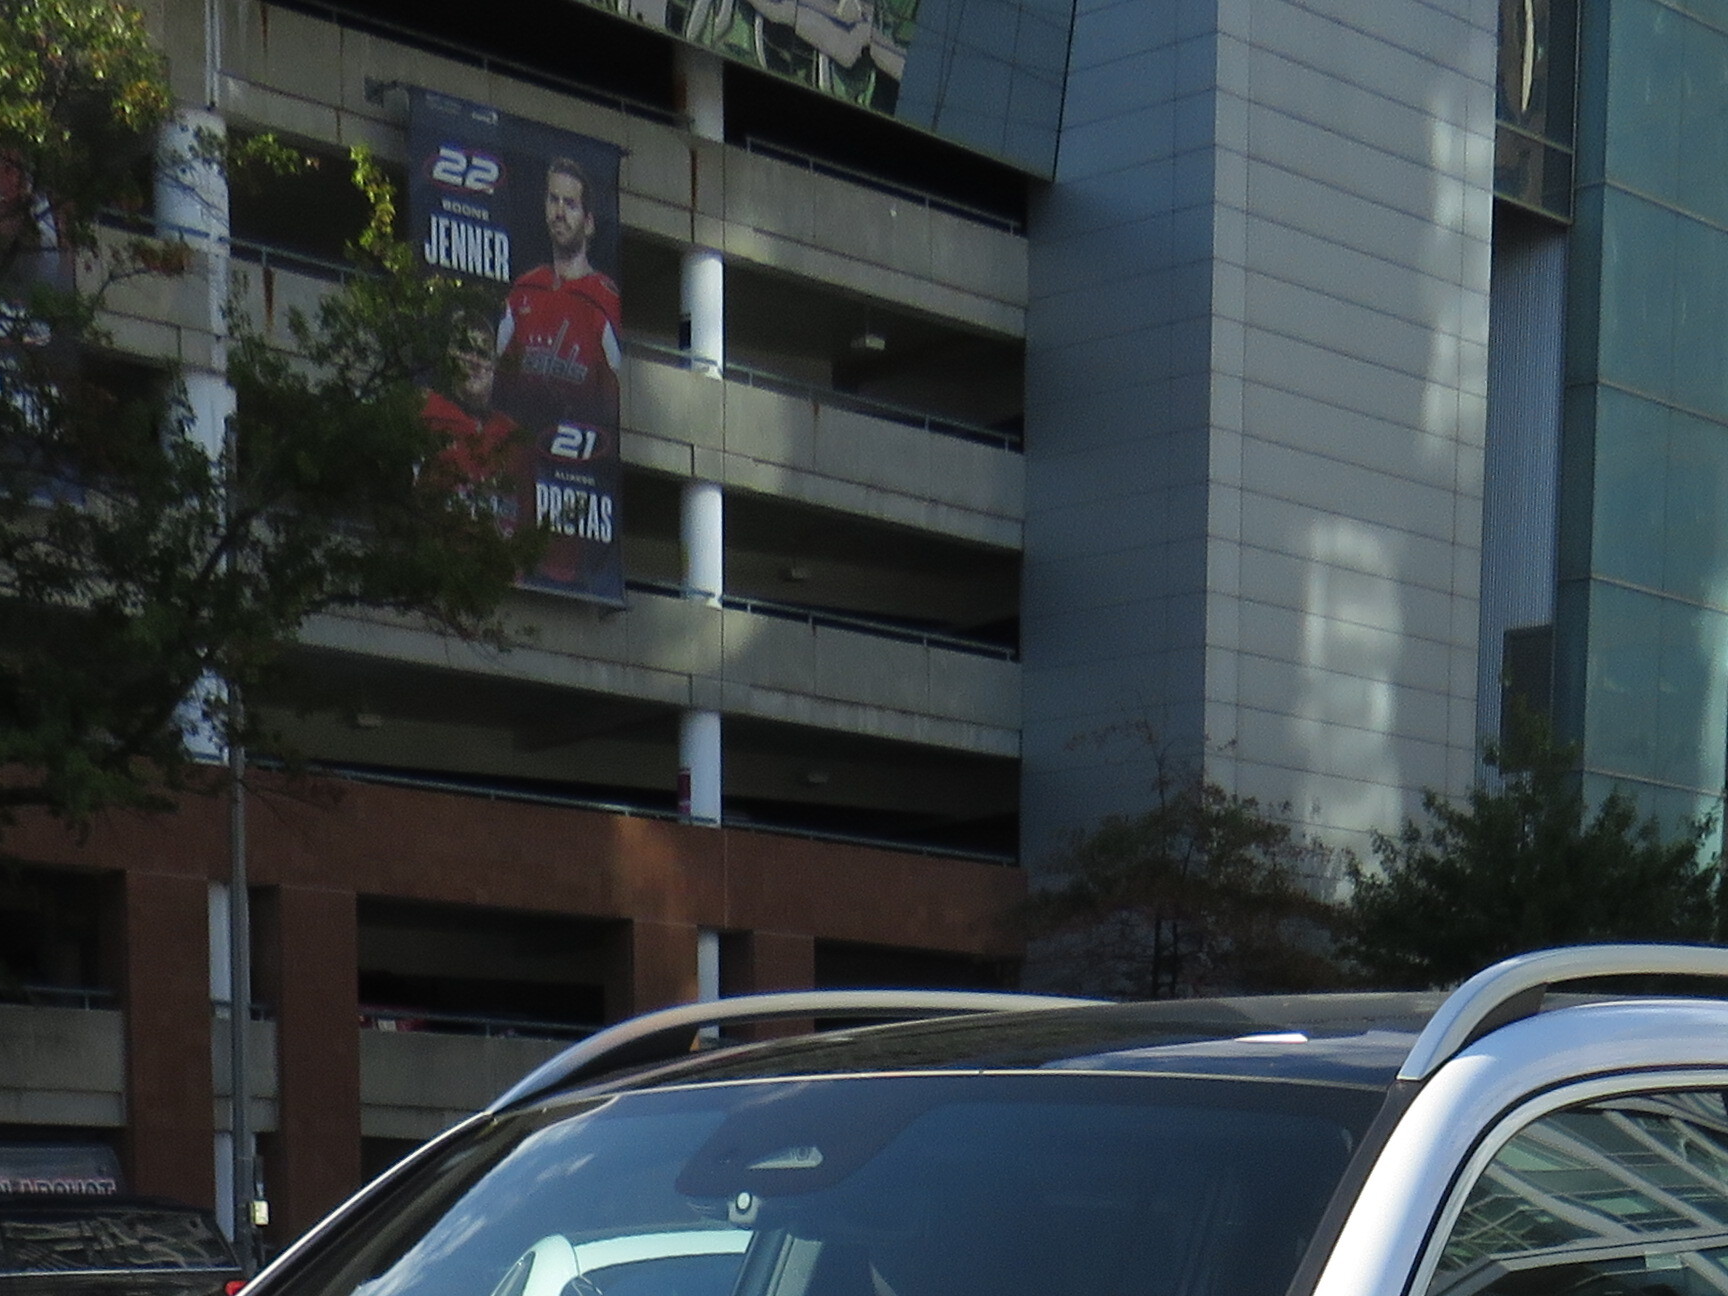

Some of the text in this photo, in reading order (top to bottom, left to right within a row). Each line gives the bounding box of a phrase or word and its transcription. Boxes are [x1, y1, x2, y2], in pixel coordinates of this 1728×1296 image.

[432, 146, 500, 194] 22
[424, 213, 511, 283] JENNER
[550, 424, 597, 460] 21
[535, 481, 613, 544] PROTAS
